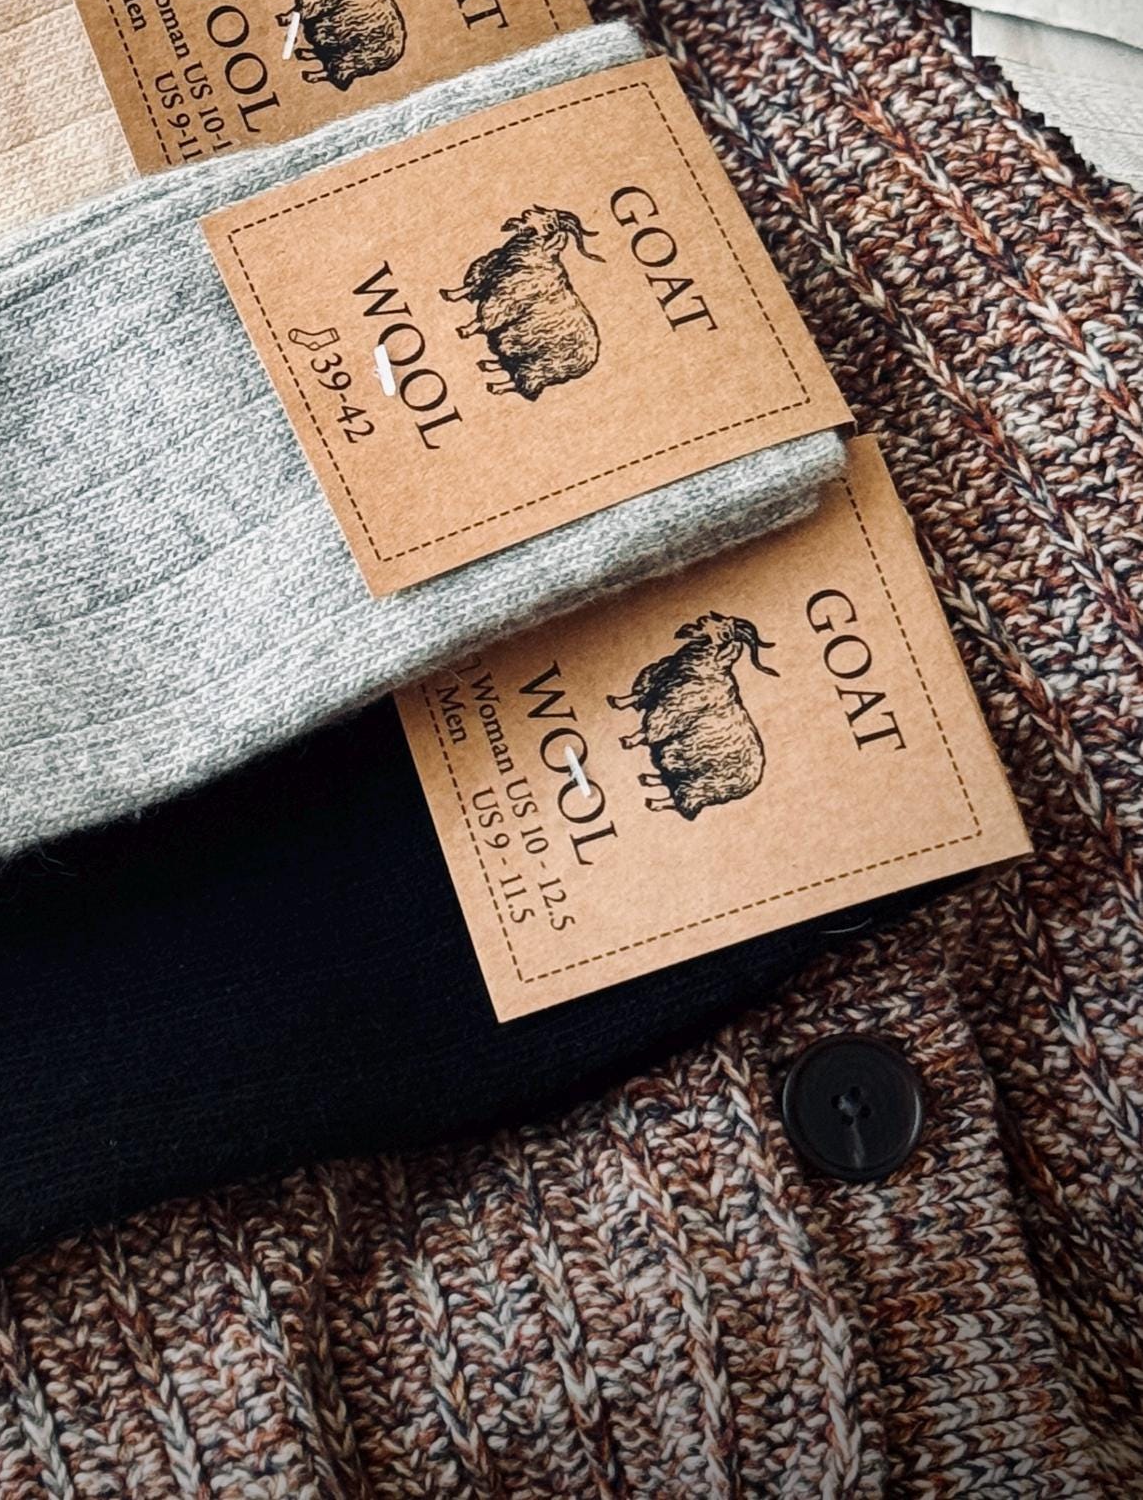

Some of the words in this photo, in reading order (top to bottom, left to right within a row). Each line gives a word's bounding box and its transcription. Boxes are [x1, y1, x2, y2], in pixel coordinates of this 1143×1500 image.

[155, 70, 185, 109] US
[183, 60, 214, 100] US
[609, 186, 718, 333] GOAT
[310, 352, 376, 444] 39-42
[352, 260, 464, 450] WOOL
[805, 588, 907, 753] GOAT
[436, 684, 468, 745] Men
[472, 786, 505, 829] US
[498, 874, 536, 925] 11.5
[471, 671, 515, 776] Woman
[506, 777, 539, 819] US
[537, 877, 576, 932] 12.5
[519, 660, 618, 867] WOOL
